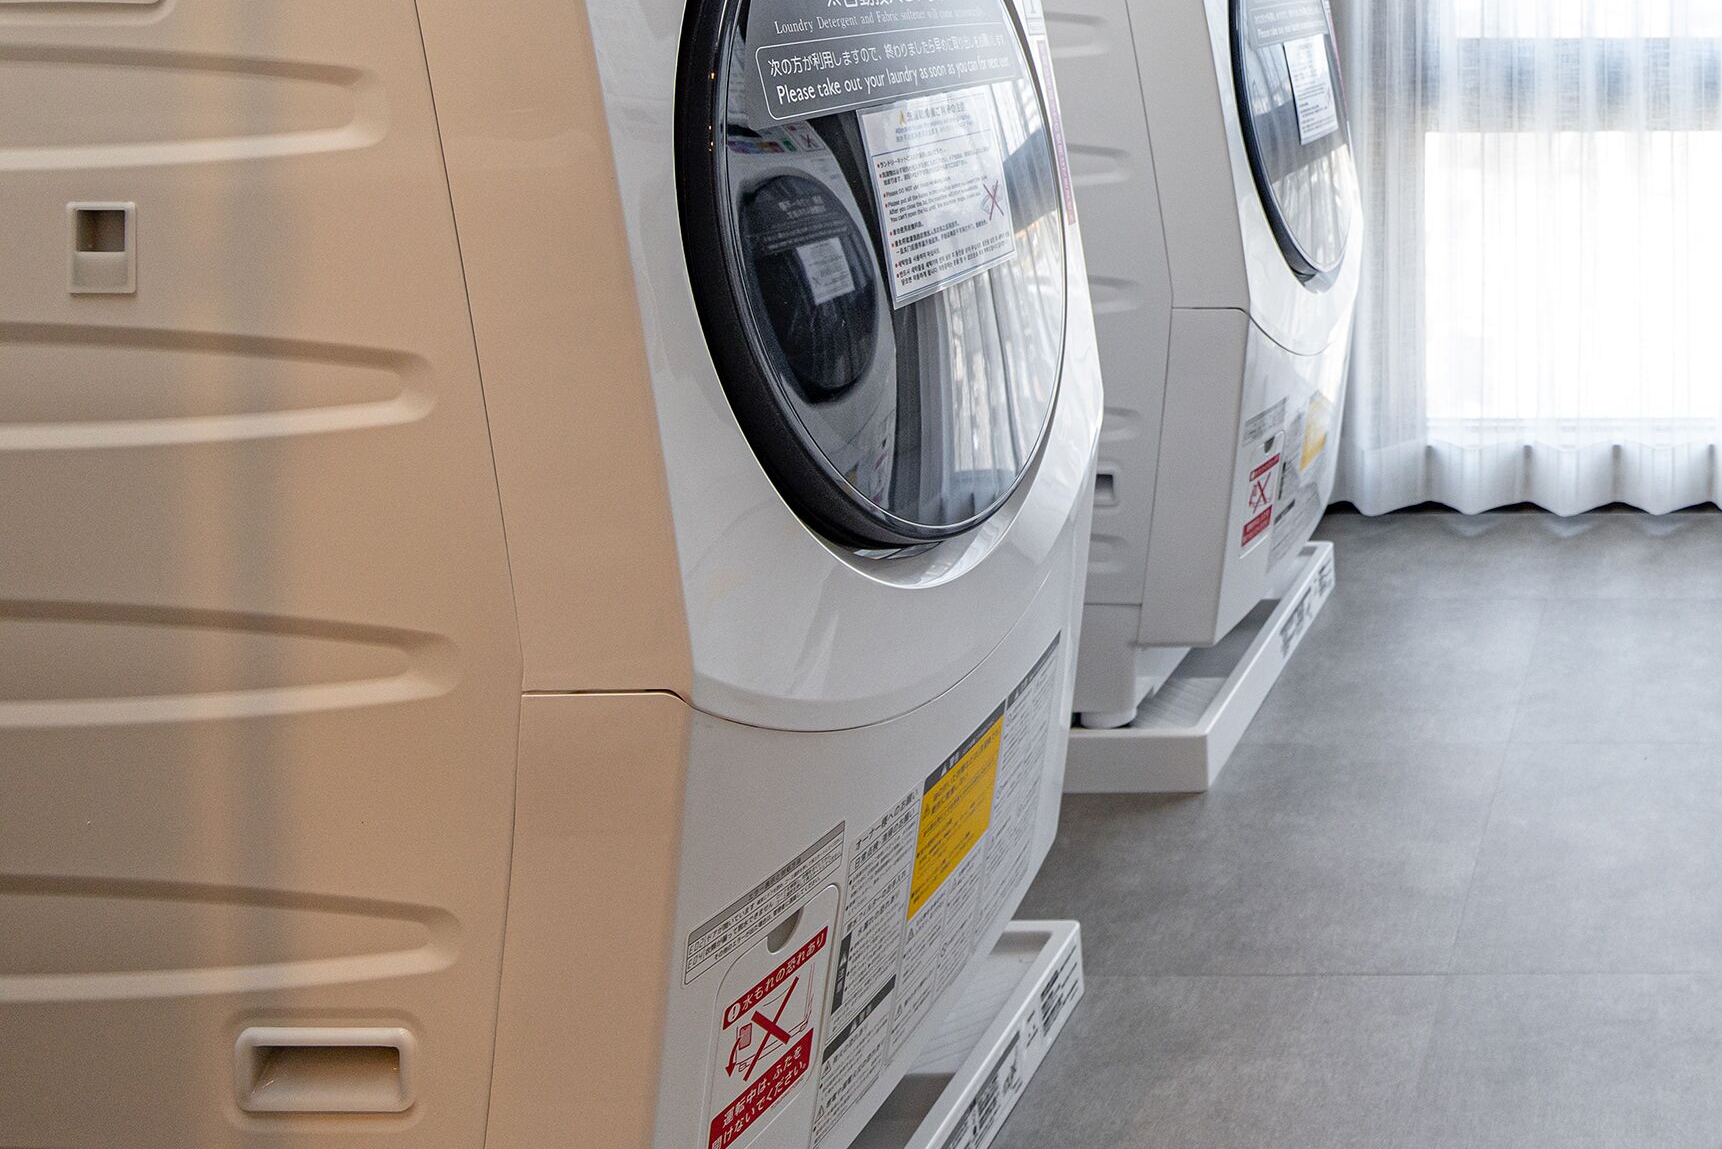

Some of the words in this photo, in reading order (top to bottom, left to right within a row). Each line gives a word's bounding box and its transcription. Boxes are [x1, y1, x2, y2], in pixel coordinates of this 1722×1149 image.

[816, 14, 858, 30] Detergent
[860, 12, 875, 24] and
[776, 83, 816, 105] Please
[817, 77, 842, 98] take
[843, 77, 863, 92] out
[864, 73, 885, 95] your
[886, 65, 918, 86] laundry
[919, 67, 928, 80] as
[928, 63, 947, 79] soon
[947, 63, 956, 76] as
[955, 63, 969, 79] you
[741, 931, 825, 1012] 水もれの恐れあり
[722, 1045, 803, 1129] 運転中は、ふたを
